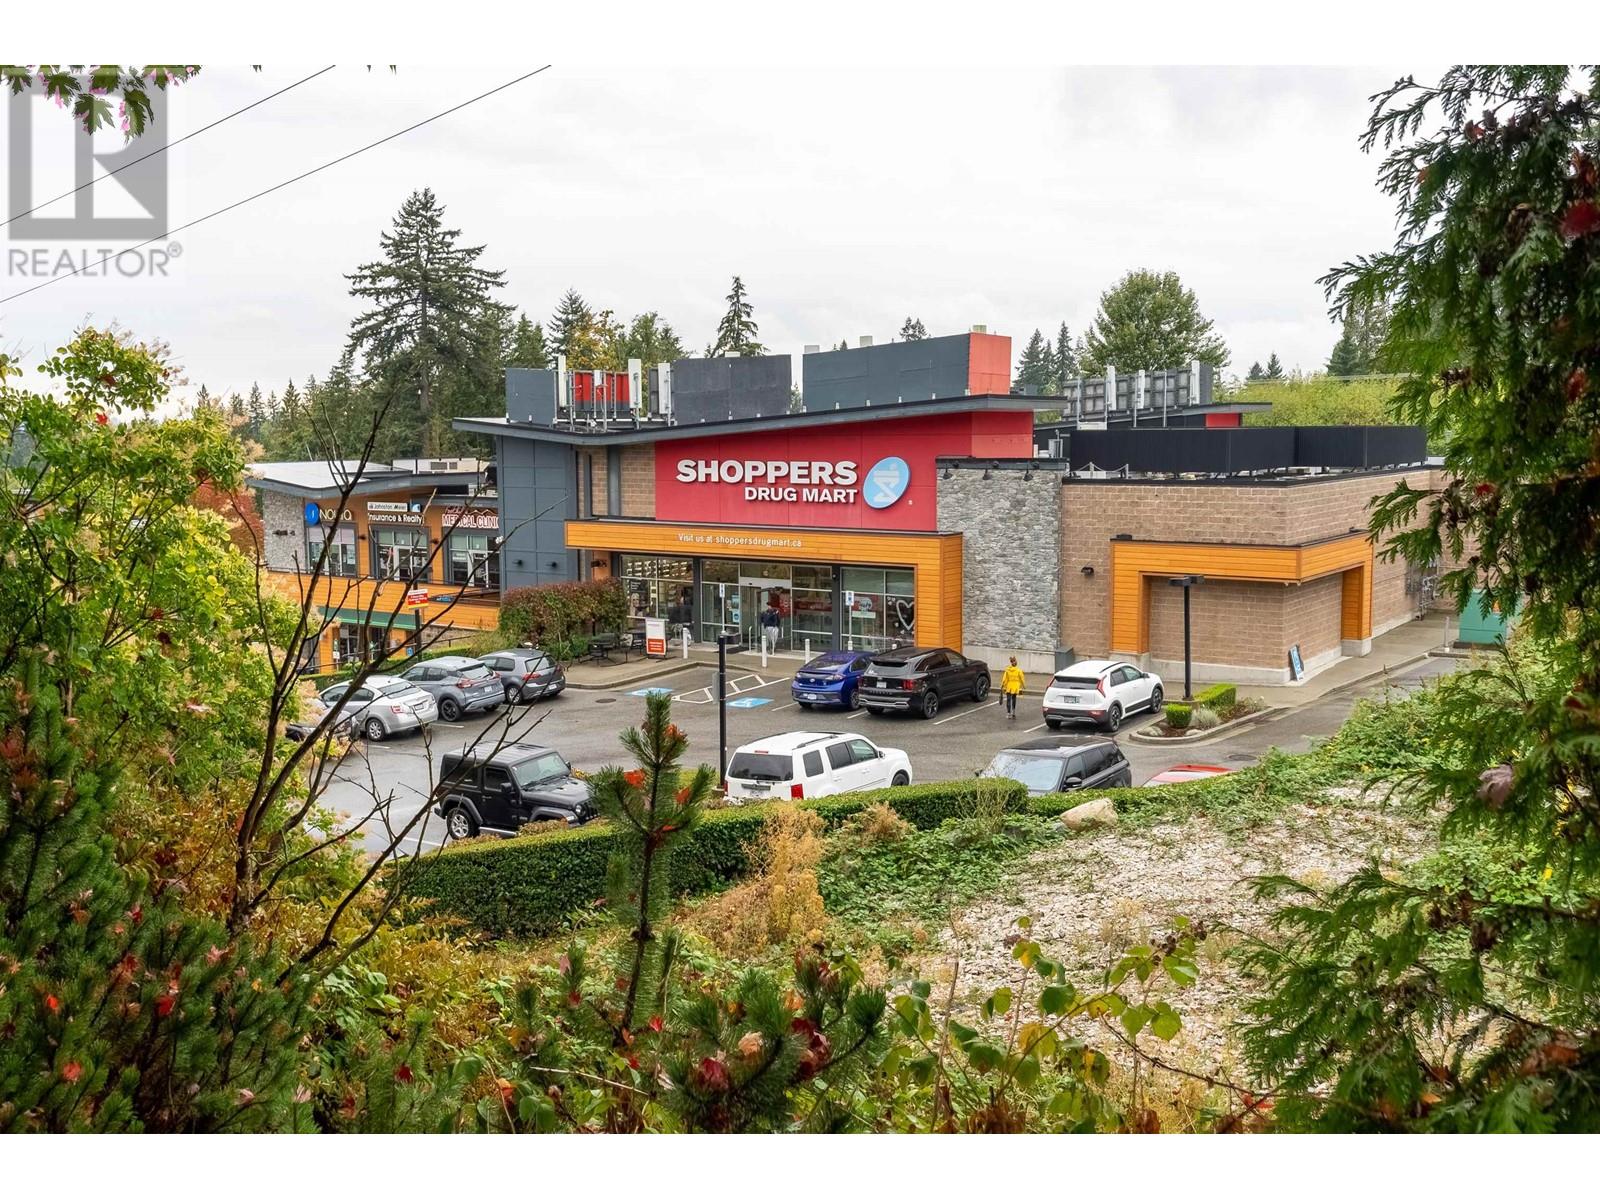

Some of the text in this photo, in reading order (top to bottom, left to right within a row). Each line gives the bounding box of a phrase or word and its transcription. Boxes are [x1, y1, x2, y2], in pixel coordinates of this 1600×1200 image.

[676, 459, 858, 485] SHOPPERS
[744, 487, 858, 504] DRUG MART
[397, 514, 402, 522] &
[402, 514, 423, 525] Realty
[677, 532, 801, 548] Visit us at shoppersdrugmart.ca
